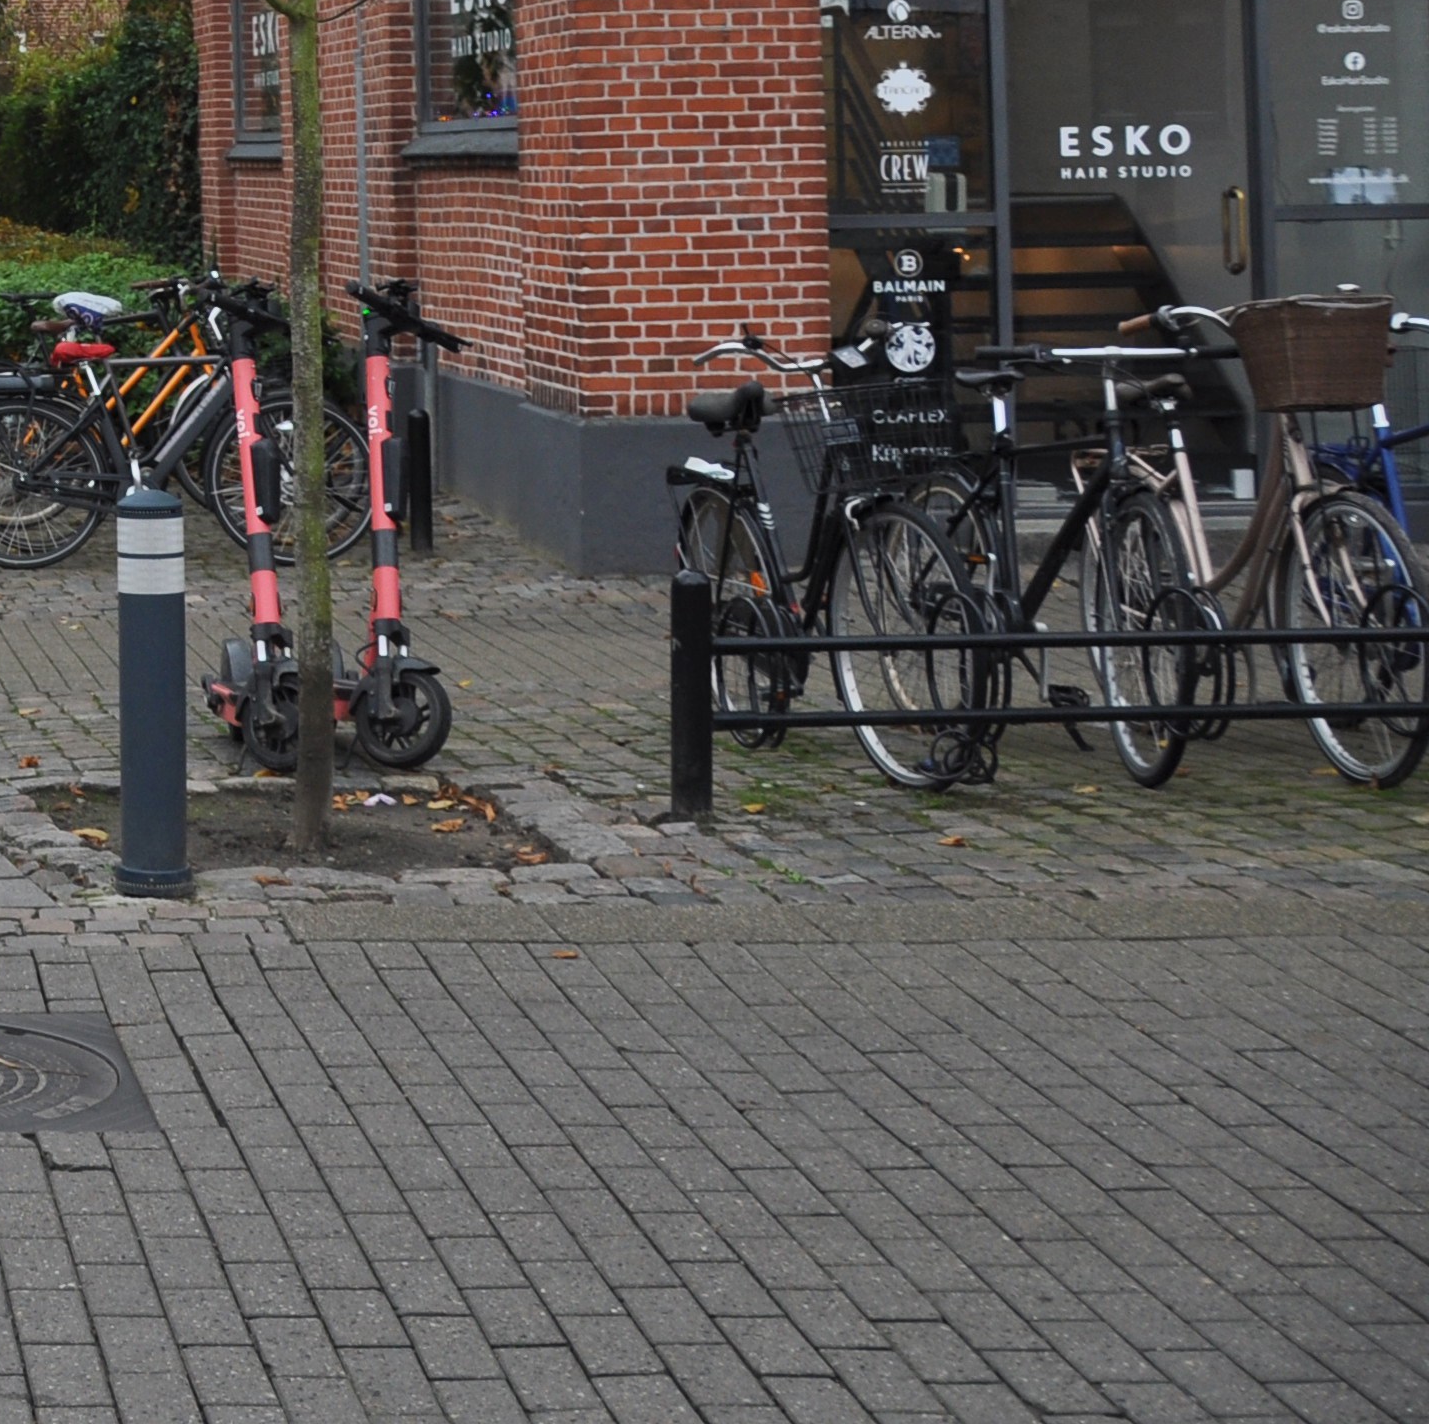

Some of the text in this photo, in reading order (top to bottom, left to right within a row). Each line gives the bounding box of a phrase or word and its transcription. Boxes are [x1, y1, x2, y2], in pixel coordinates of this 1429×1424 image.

[864, 25, 935, 40] ALTERNA
[452, 35, 473, 57] HAIR
[1059, 124, 1191, 157] ESKO
[879, 154, 930, 181] CREW
[1060, 164, 1193, 179] HAIR STUDIO
[901, 255, 917, 272] B
[873, 280, 946, 293] BALMAIN
[895, 295, 924, 303] PARIS
